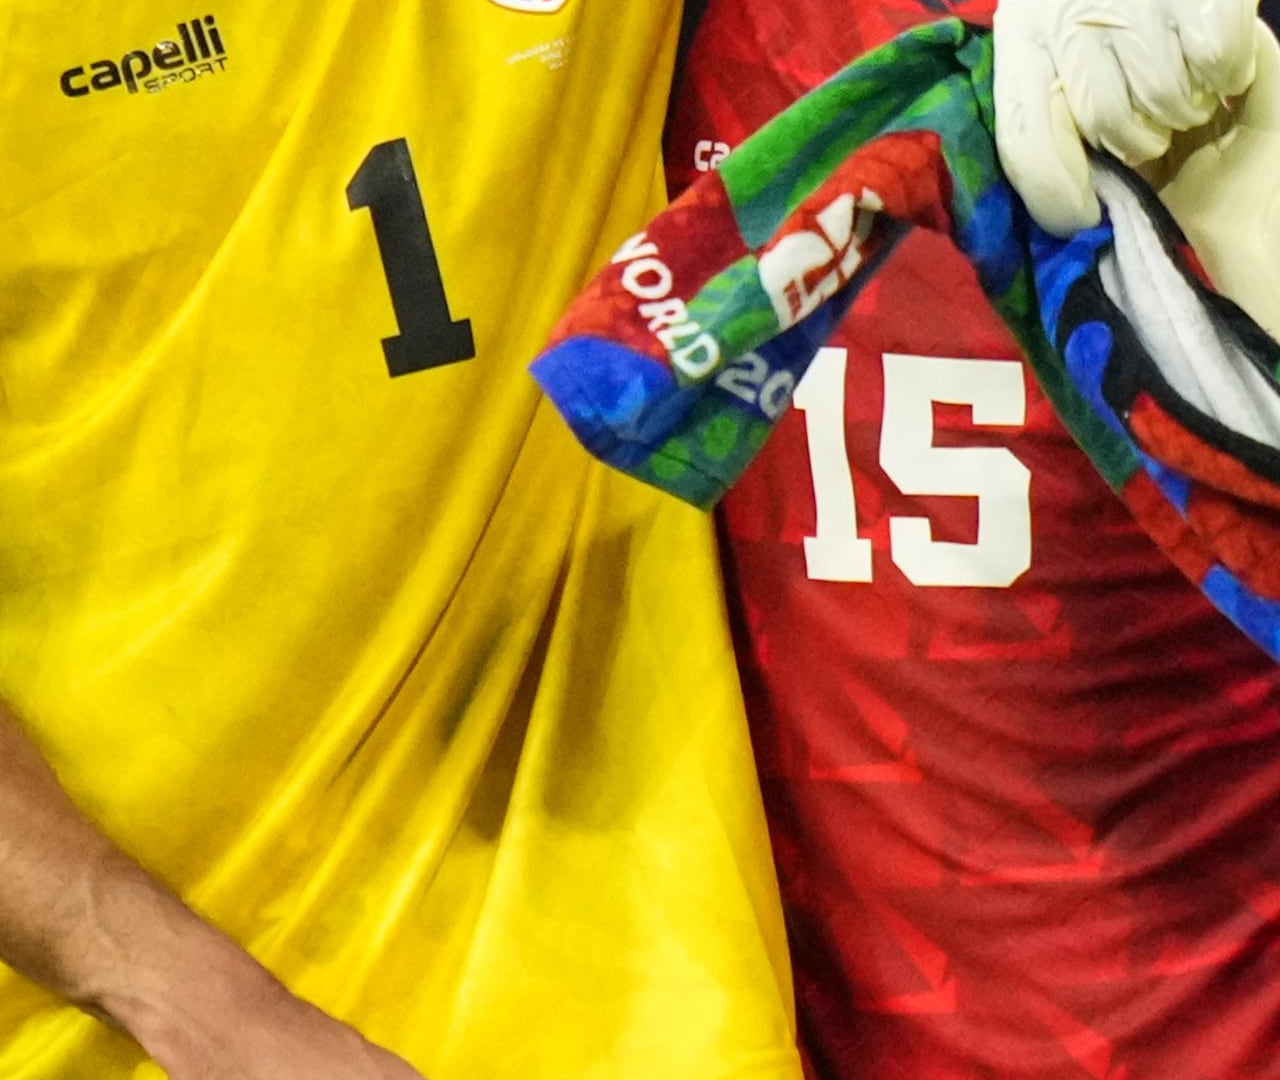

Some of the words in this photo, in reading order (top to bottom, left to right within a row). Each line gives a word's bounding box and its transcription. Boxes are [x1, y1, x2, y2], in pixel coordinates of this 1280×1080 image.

[60, 15, 226, 97] capelli
[144, 56, 228, 93] SPORT
[346, 137, 476, 379] 1
[793, 347, 1031, 588] 15
